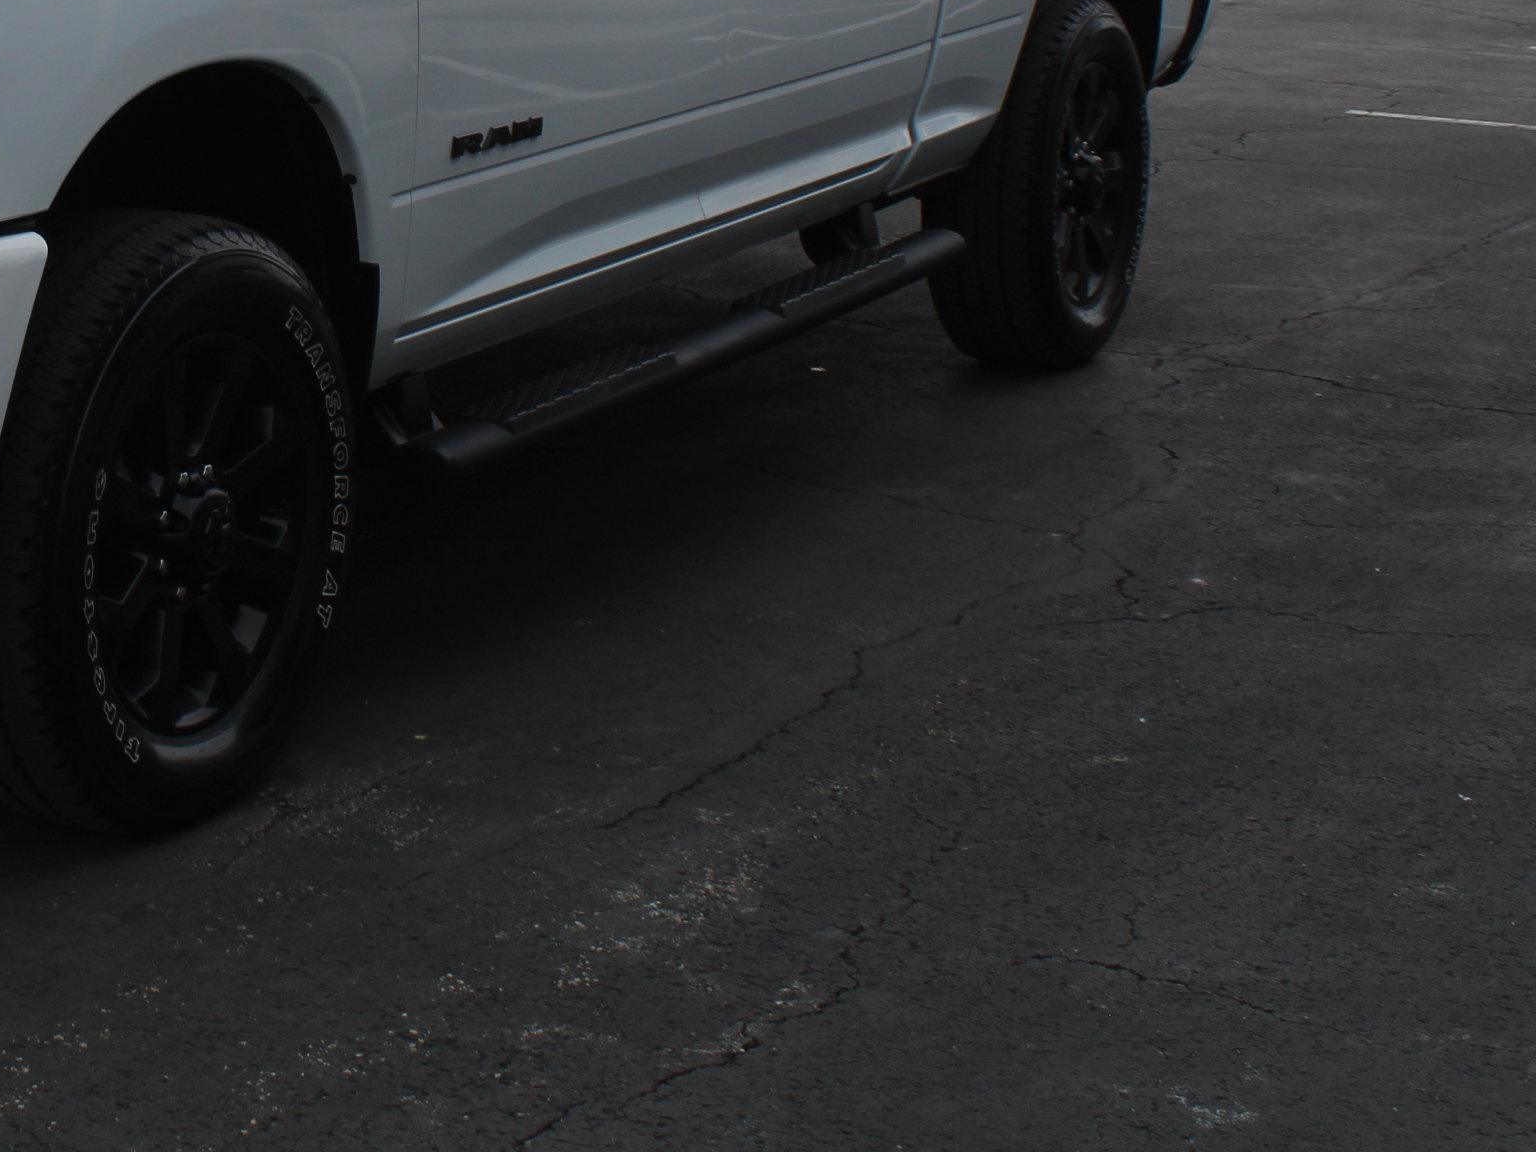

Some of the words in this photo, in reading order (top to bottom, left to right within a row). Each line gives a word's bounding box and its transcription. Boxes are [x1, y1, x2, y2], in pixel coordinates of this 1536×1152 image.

[450, 115, 544, 158] RAM
[284, 305, 350, 555] TRANSFORCE
[318, 568, 338, 630] AT
